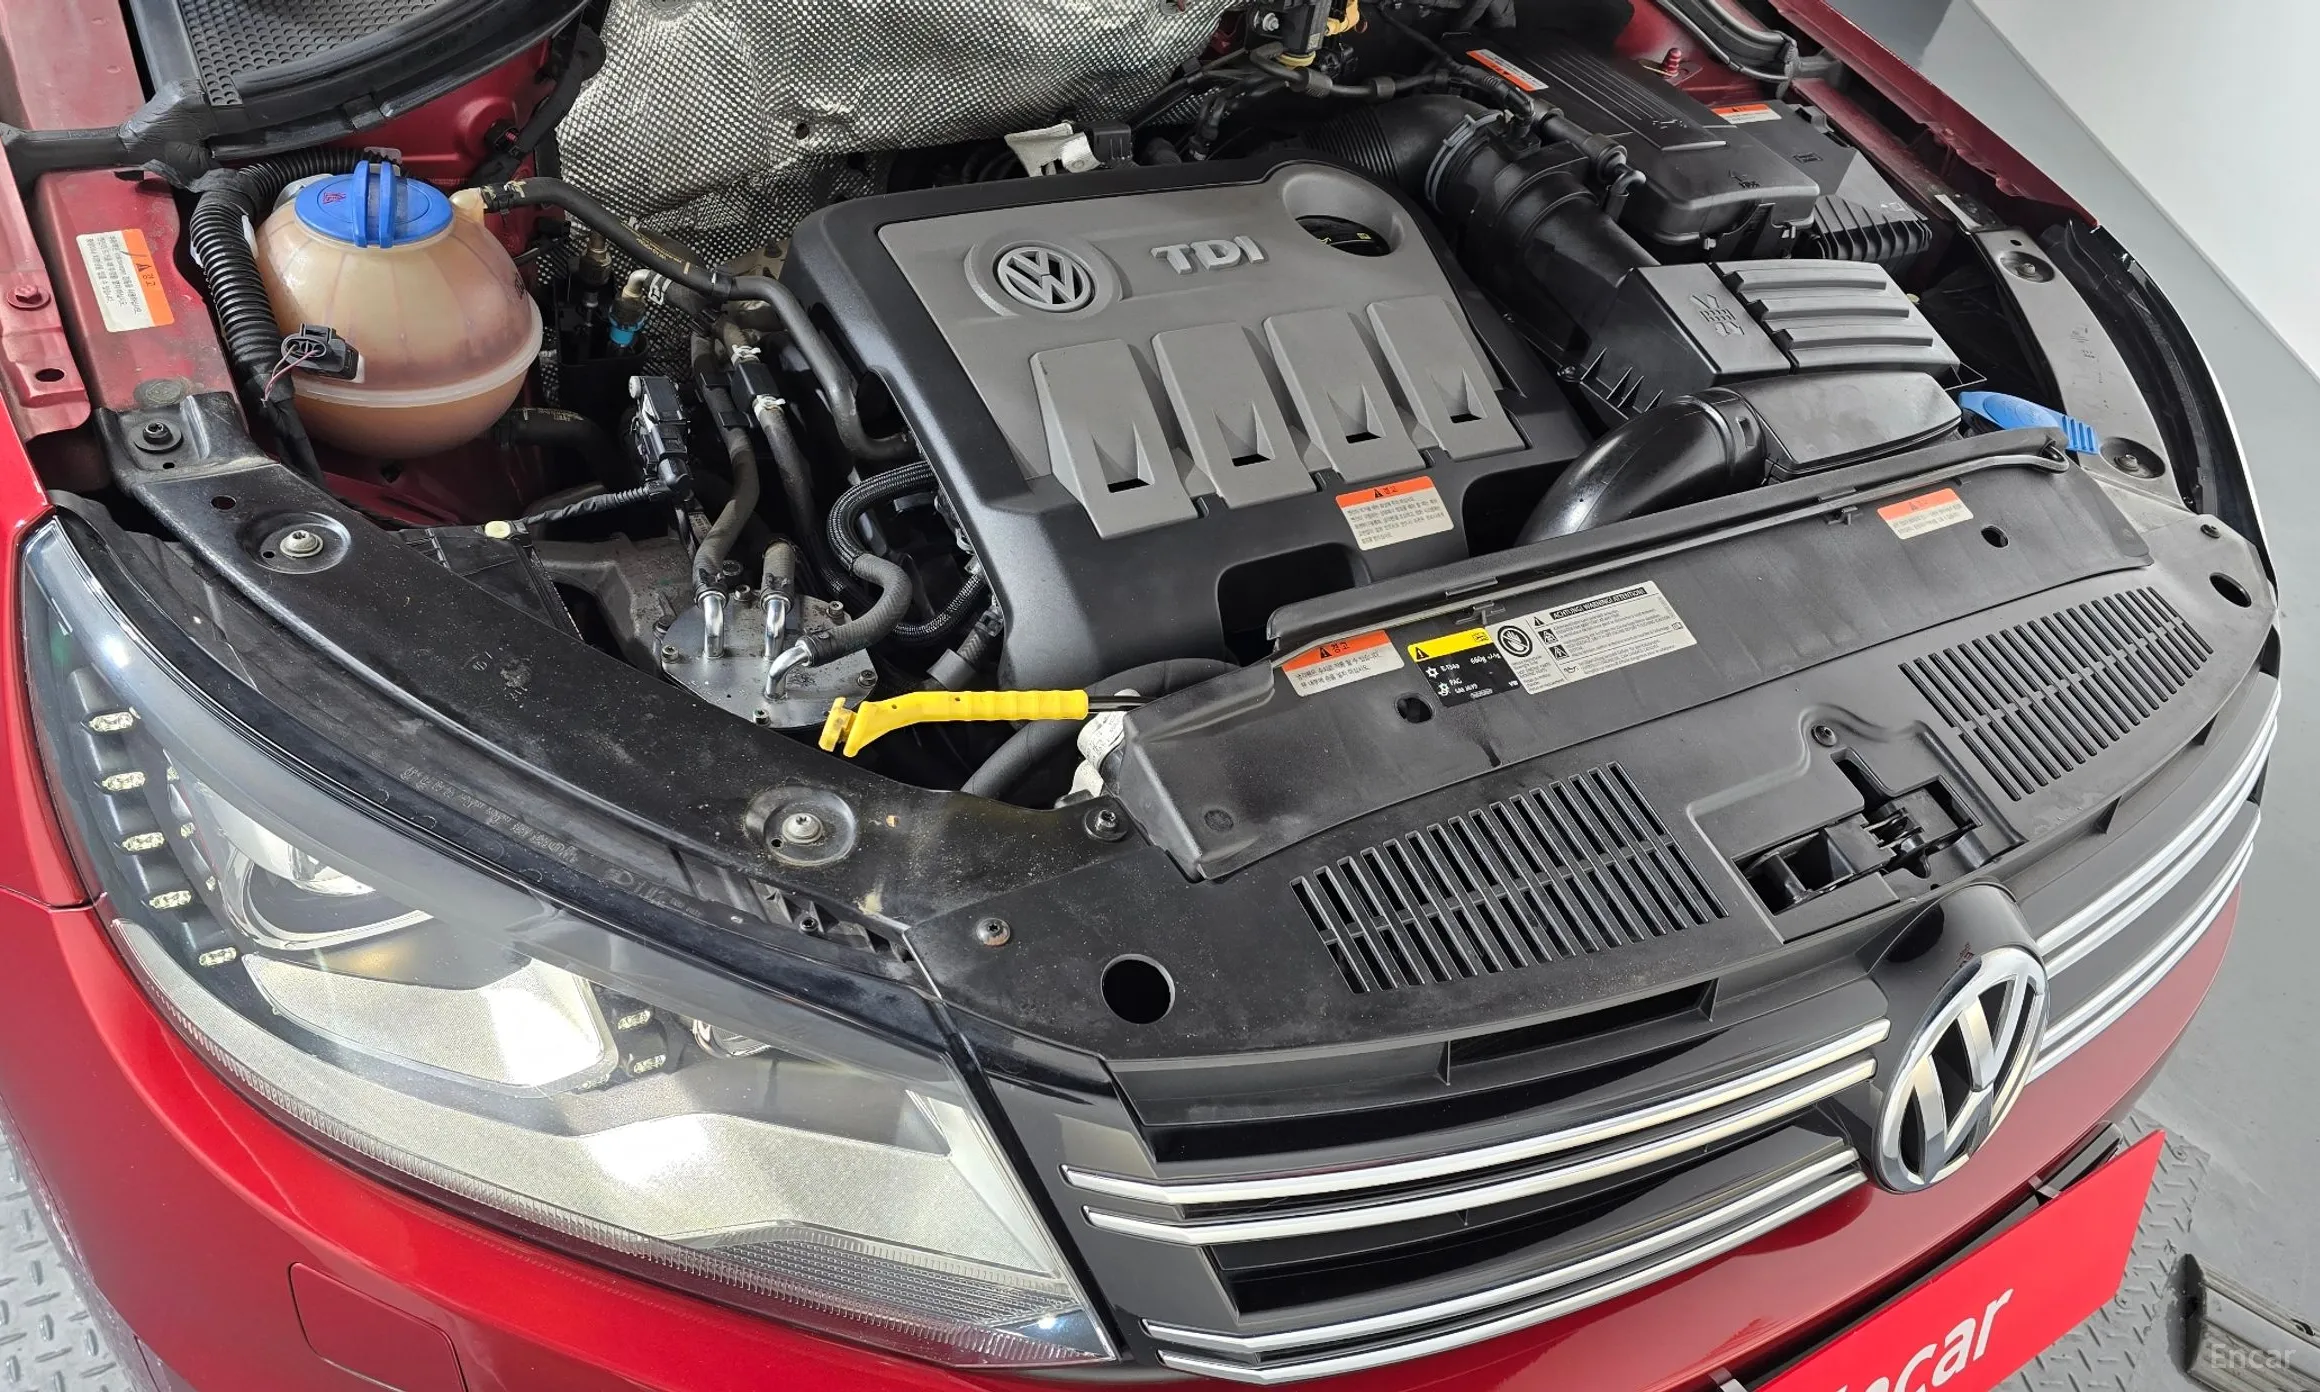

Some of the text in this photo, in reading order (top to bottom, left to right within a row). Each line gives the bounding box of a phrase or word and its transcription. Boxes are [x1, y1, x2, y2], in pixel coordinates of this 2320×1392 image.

[1150, 235, 1265, 275] TDI
[143, 273, 156, 287] 경고
[1331, 641, 1350, 654] 경고
[1836, 1288, 2014, 1392] car
